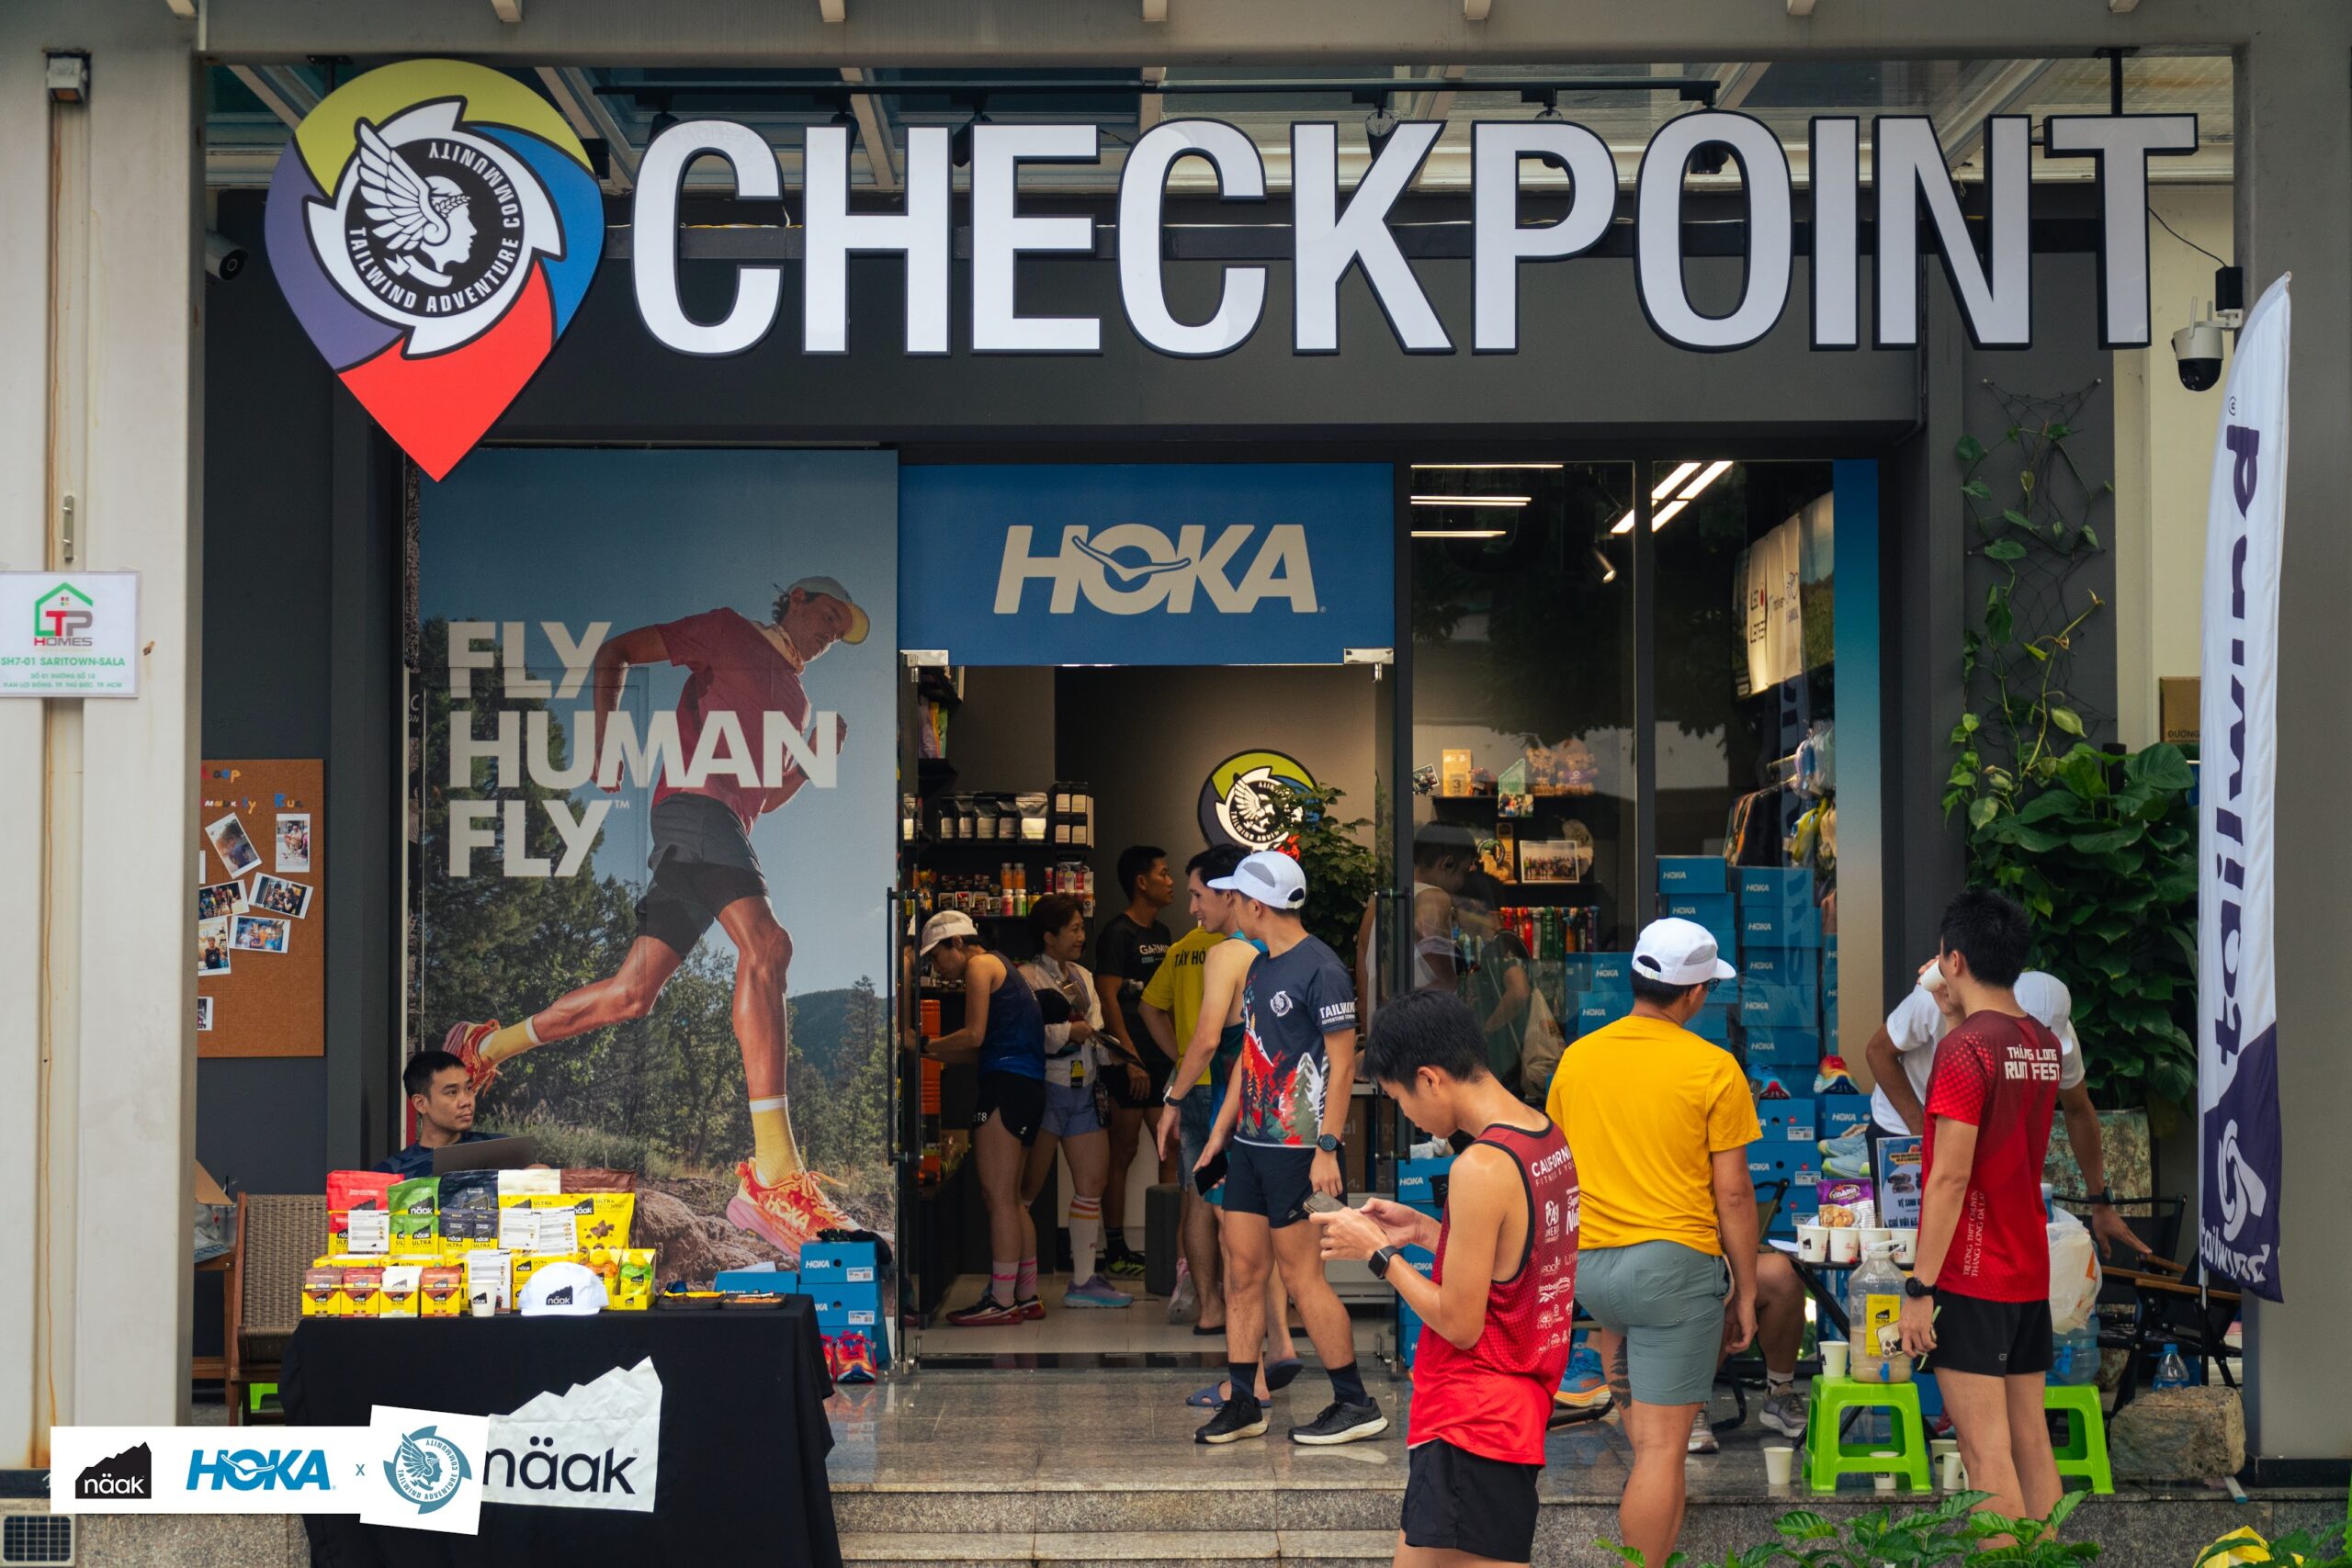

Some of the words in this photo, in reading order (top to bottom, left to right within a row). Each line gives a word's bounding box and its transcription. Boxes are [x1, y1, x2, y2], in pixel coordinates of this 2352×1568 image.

[428, 141, 521, 229] COMMUNITY
[631, 111, 2198, 356] CHECKPOINT
[348, 227, 417, 309] TAILWIND
[425, 238, 519, 312] ADVENTURE
[993, 523, 1318, 615] HOKA
[34, 637, 93, 647] HOMES
[40, 657, 125, 666] SARITOWN-SALA
[448, 621, 612, 698] FLY
[449, 710, 837, 789] HUMAN
[448, 800, 613, 877] FLY
[1663, 871, 1687, 879] HOKA
[1746, 884, 1770, 892] HOKA
[1747, 922, 1772, 931] HOKA
[1749, 962, 1774, 970] HOKA
[1595, 969, 1619, 977] HOKA
[1746, 1001, 1770, 1010] HOKA
[1582, 1008, 1606, 1016] HOKA
[1751, 1042, 1775, 1050] HOKA
[2030, 1062, 2060, 1080] FEST
[1831, 1112, 1857, 1121] HOKA
[1399, 1177, 1424, 1186] HOKA
[410, 1206, 433, 1215] näak
[763, 1195, 810, 1230] HOKA
[805, 1259, 830, 1269] HOKA
[548, 1294, 571, 1305] näak
[483, 1436, 638, 1495] näak
